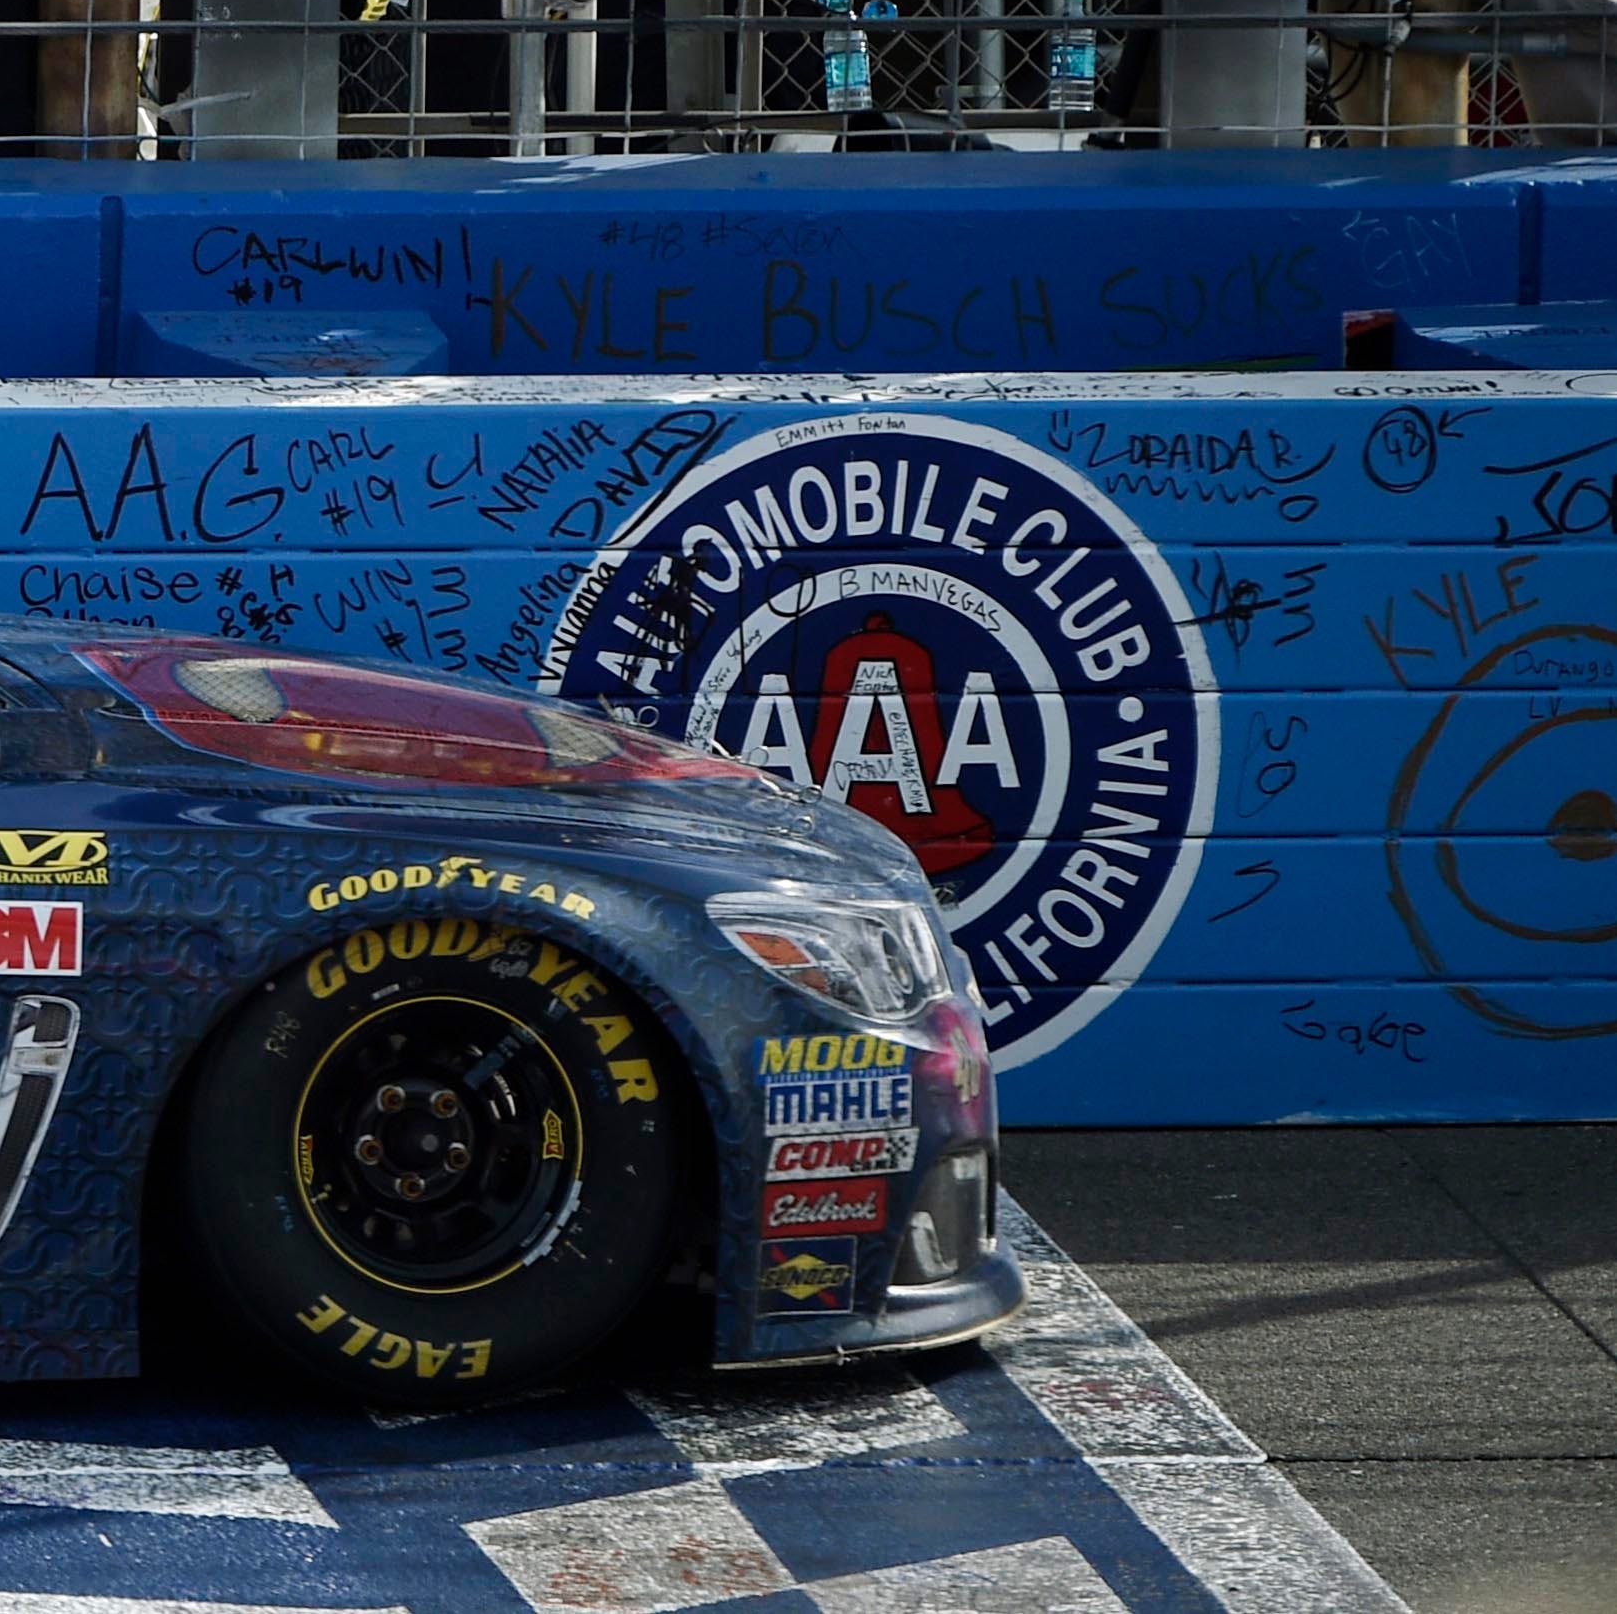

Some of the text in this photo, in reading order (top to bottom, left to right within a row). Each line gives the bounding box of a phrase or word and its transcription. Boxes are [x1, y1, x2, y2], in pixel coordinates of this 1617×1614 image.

[226, 274, 303, 305] #19
[490, 244, 1324, 364] KYLE BUSCH SUCKS
[287, 427, 395, 493] CARL
[320, 475, 405, 537] #19
[19, 564, 203, 606] Chaise
[596, 460, 1153, 700] AUTOMOBILE CLUB
[1365, 553, 1541, 688] KYLE
[740, 659, 1022, 814] AAA
[55, 865, 109, 885] WEAR
[307, 855, 597, 922] GOODYEAR
[305, 917, 661, 1106] GOODYEAR
[759, 1033, 908, 1076] MOOG
[768, 1077, 911, 1126] MAHLE
[775, 1136, 887, 1172] COMP
[768, 1189, 879, 1228] Edelbrock
[762, 1265, 852, 1289] SUNOCO
[294, 1294, 493, 1380] EAGLE
